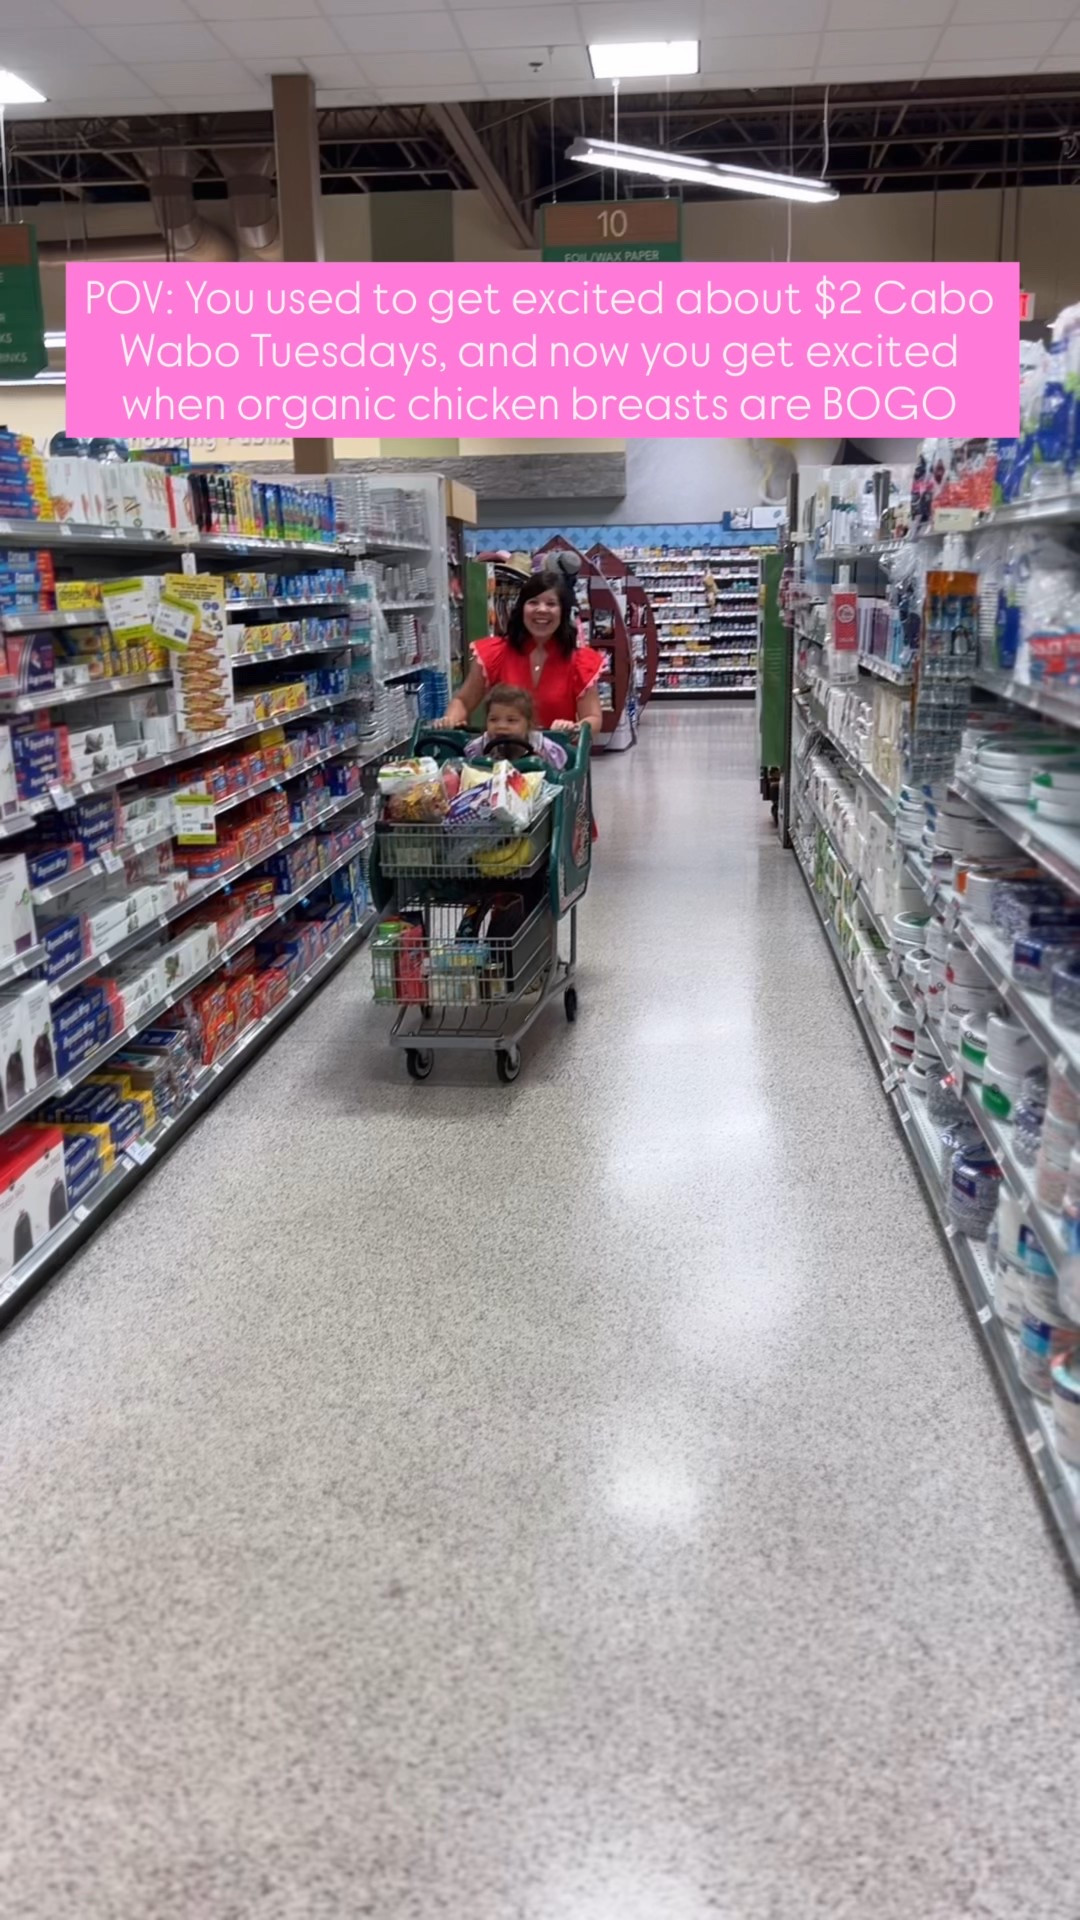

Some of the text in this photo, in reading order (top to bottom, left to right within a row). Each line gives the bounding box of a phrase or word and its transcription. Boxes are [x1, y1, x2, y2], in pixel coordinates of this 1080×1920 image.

[597, 209, 628, 238] 10
[563, 249, 660, 262] FOIL/WAX PAPER
